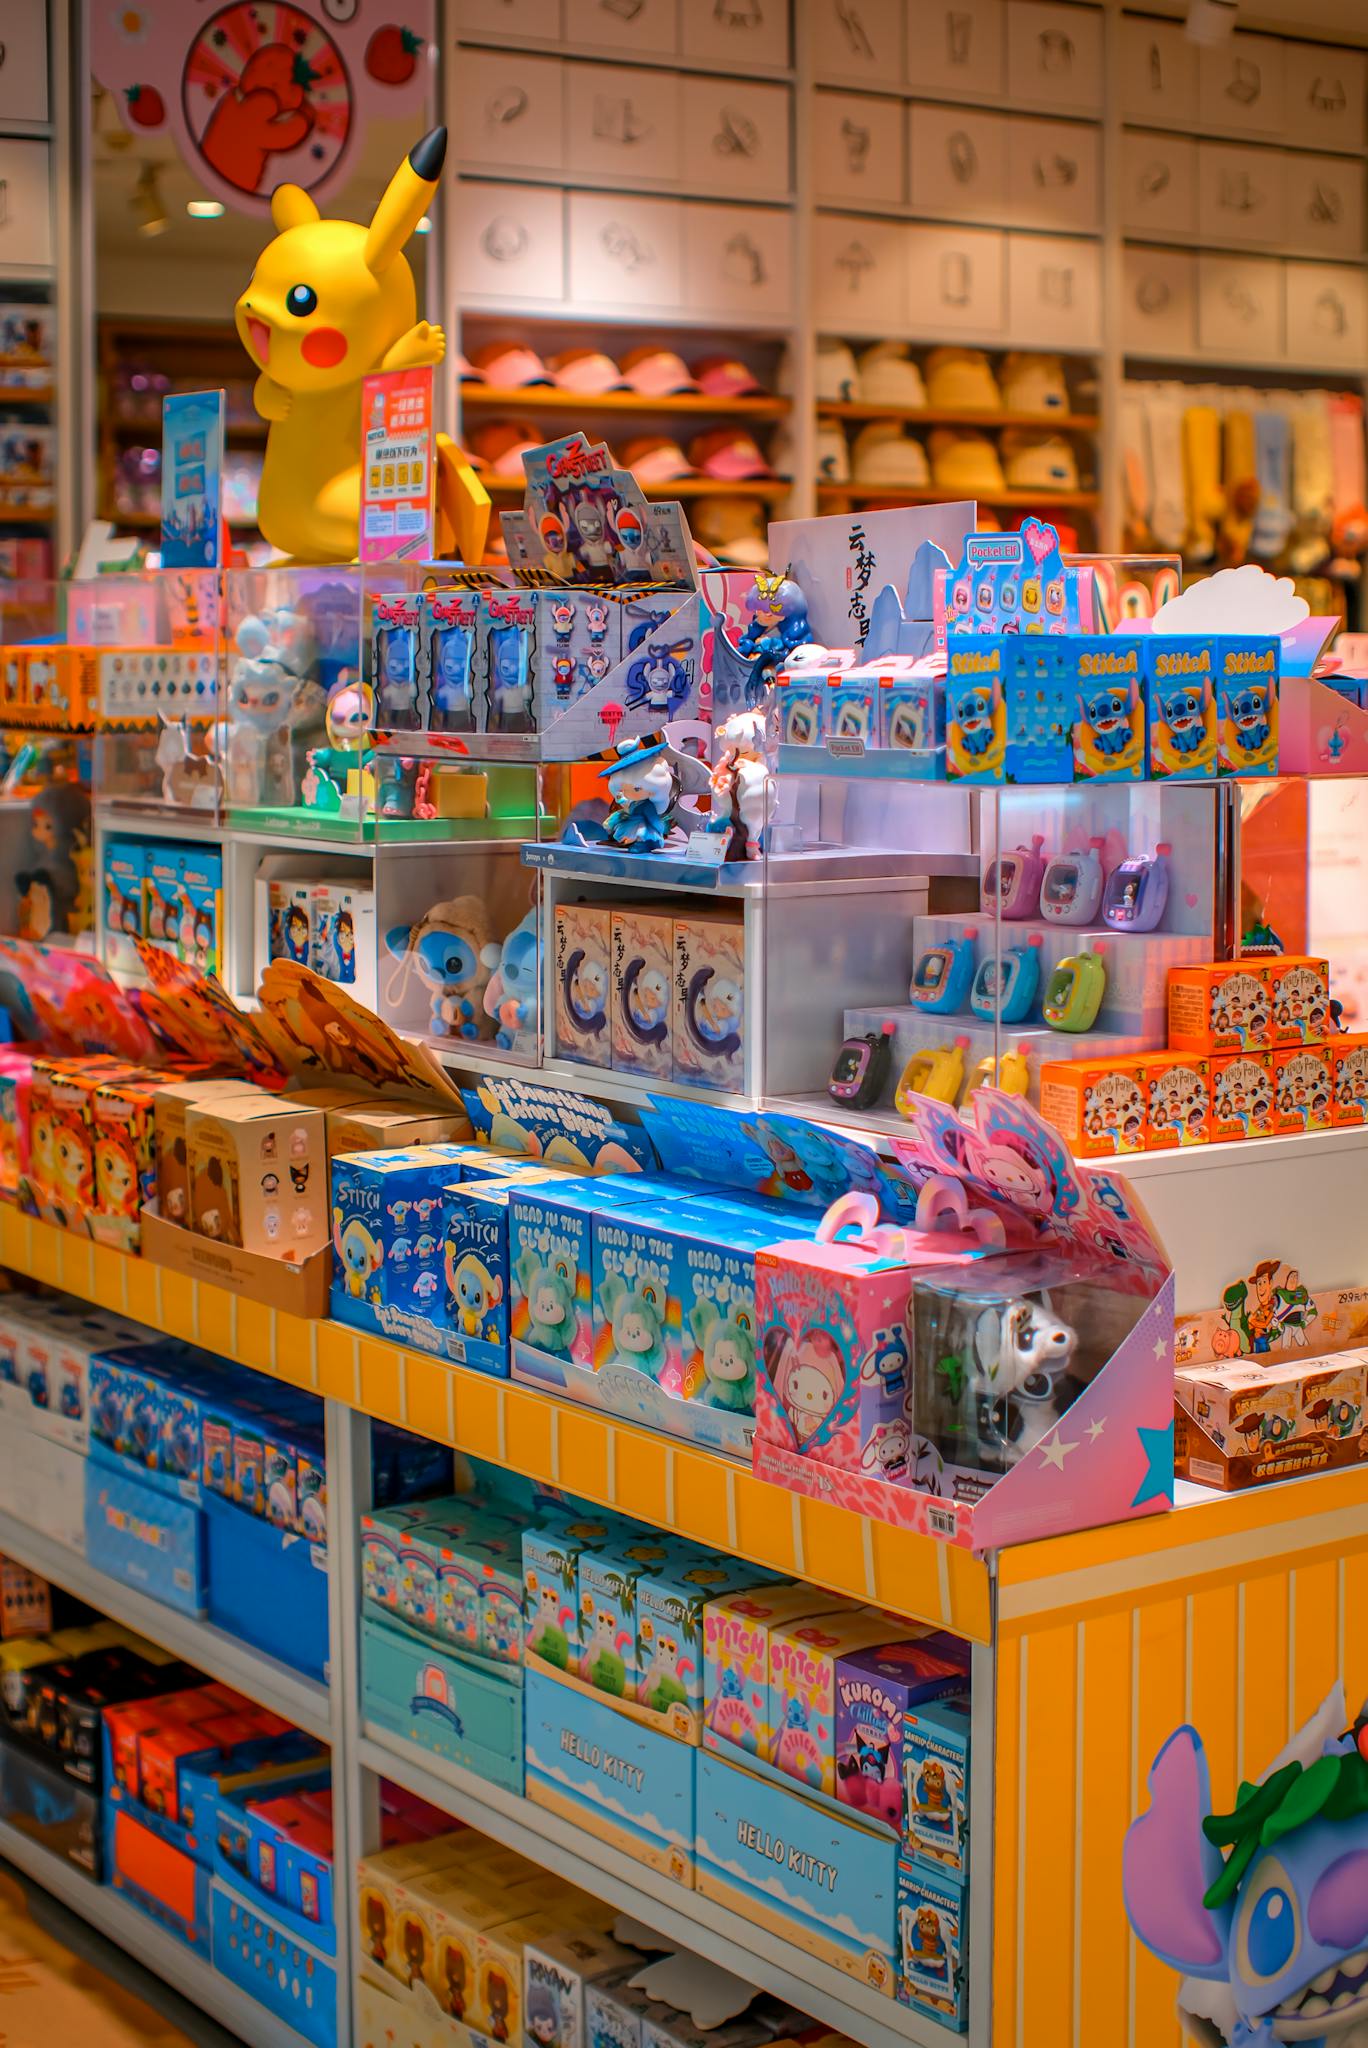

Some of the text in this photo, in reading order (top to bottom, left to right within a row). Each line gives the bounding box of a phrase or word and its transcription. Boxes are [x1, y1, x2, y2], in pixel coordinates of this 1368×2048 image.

[971, 545, 1017, 558] Pocket Elf
[950, 649, 1000, 676] Stitch
[1078, 650, 1138, 676] Stitch
[1155, 650, 1210, 677] Stitch
[1224, 650, 1275, 675] Stitch
[510, 1078, 613, 1124] Something
[557, 1108, 607, 1140] Sleep
[338, 1182, 380, 1210] STITCH
[451, 1213, 499, 1245] STITCH
[514, 1204, 583, 1236] HEAD IN THE
[598, 1226, 673, 1260] HEAD IN THE
[688, 1248, 721, 1272] HEAD
[724, 1257, 740, 1276] IN
[692, 1272, 754, 1307] CLOUD
[526, 1544, 572, 1574] HELLO KITTY
[581, 1566, 631, 1597] HELLO KITTY
[640, 1591, 693, 1623] HELLO KITTY
[705, 1616, 764, 1659] STITCH
[771, 1644, 830, 1690] STITCH
[841, 1681, 902, 1725] KUROMI
[560, 1728, 645, 1793] HELLO KITTY
[904, 1730, 925, 1746] SANRIO
[926, 1739, 964, 1763] CHARACTERS
[737, 1819, 838, 1892] HELLO KITTY
[921, 1888, 960, 1912] CHARACTERS
